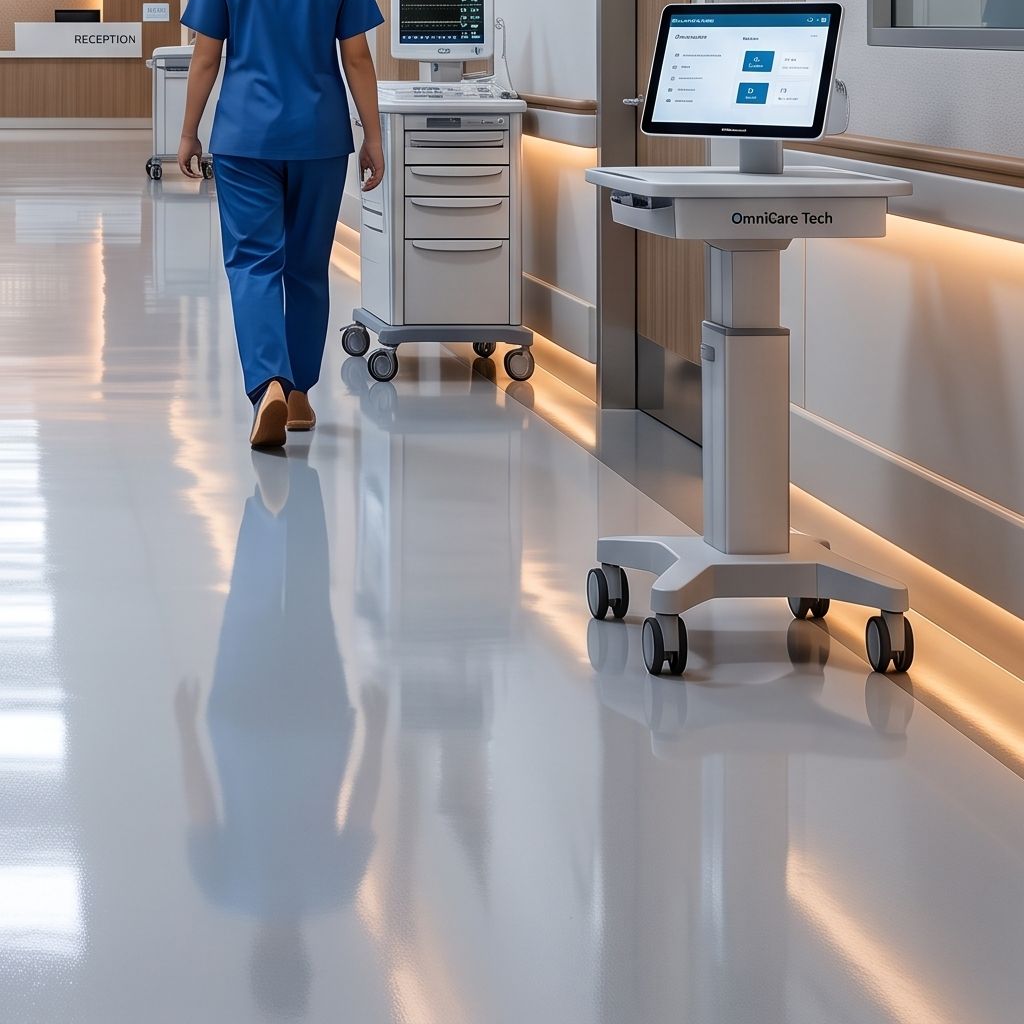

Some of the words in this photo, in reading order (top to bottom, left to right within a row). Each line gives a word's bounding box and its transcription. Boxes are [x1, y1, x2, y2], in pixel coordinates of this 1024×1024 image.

[74, 34, 136, 44] RECEPTION
[731, 211, 799, 225] OmniCare
[801, 211, 833, 225] Tech
